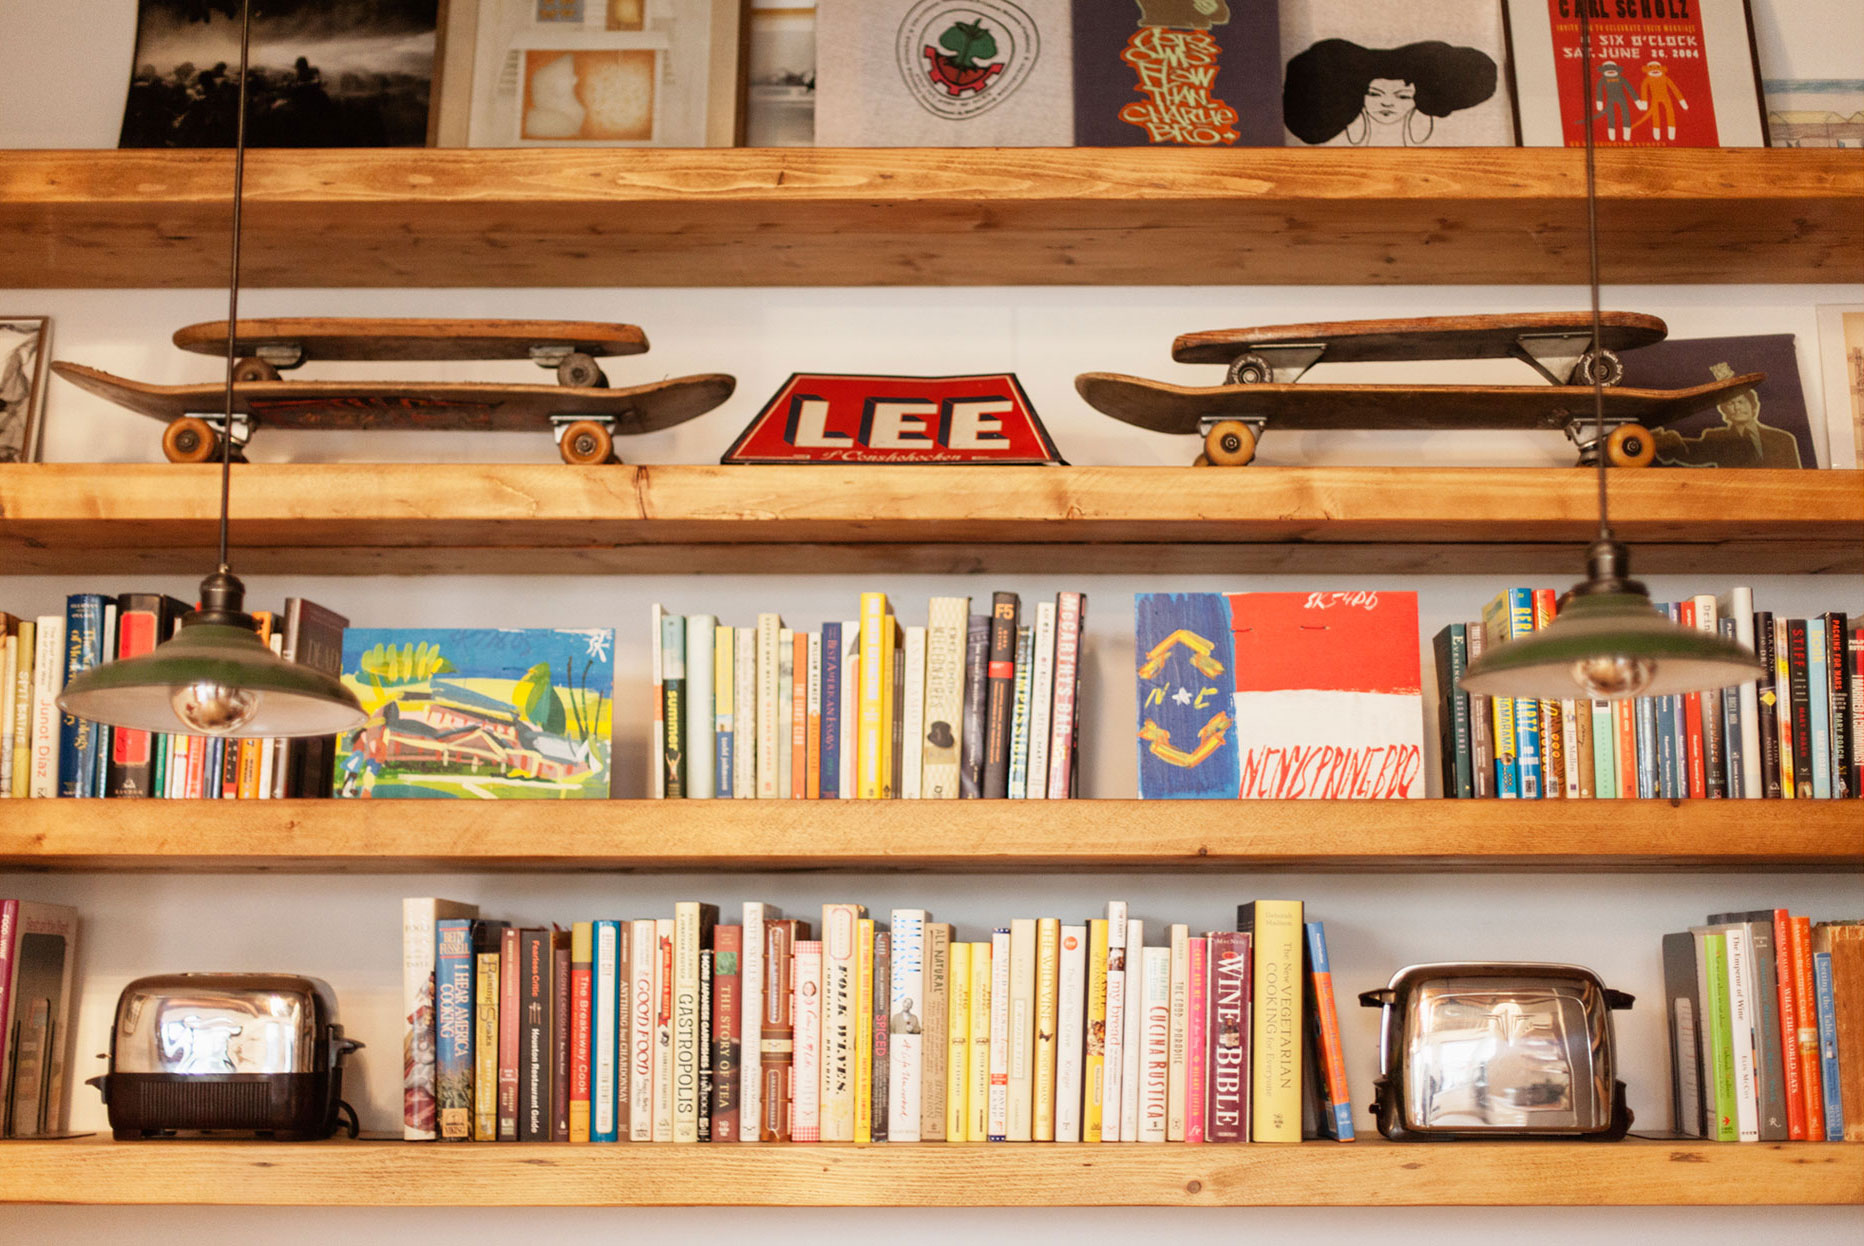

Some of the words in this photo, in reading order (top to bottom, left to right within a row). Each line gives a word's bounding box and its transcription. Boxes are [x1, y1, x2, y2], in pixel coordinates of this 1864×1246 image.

[1616, 0, 1690, 18] SCHOLZ
[1598, 48, 1641, 59] JUNE
[1599, 35, 1625, 46] SIX
[1631, 35, 1698, 47] O'CLOCK
[785, 393, 1014, 450] LEE
[994, 603, 1015, 620] F5
[71, 630, 83, 645] of
[826, 639, 838, 660] BEST
[1766, 620, 1775, 672] LEARNING
[1791, 628, 1805, 668] STIFF
[1811, 630, 1825, 663] bonk
[1832, 619, 1841, 652] PACKING
[1453, 635, 1464, 682] EVENING
[1833, 654, 1842, 669] FOR
[17, 671, 30, 701] SPIT
[825, 662, 838, 715] AMERICAN
[1834, 670, 1843, 690] MARS
[16, 703, 29, 744] BATHS
[39, 698, 51, 740] Junot
[667, 690, 679, 751] summer
[1055, 703, 1072, 735] BAR
[1456, 695, 1465, 722] SUSAN
[1798, 706, 1806, 728] MARY
[1834, 712, 1844, 733] MARY
[825, 717, 838, 751] ESSAYS
[1799, 731, 1808, 757] ROACH
[1816, 730, 1826, 750] MARY
[1836, 735, 1845, 759] ROACH
[37, 746, 50, 778] Díaz
[1568, 745, 1577, 772] Mullen
[1818, 751, 1828, 778] ROACH
[935, 929, 946, 946] ALL
[1043, 927, 1054, 953] THE
[1283, 942, 1293, 960] The
[1732, 936, 1742, 951] The
[531, 940, 541, 974] Fearless
[700, 955, 710, 979] MORE
[749, 945, 759, 984] SKILLS
[1193, 948, 1201, 971] CANDY
[1804, 938, 1812, 969] ROLAND
[559, 961, 568, 997] DISCOVER
[1041, 955, 1054, 991] WILD
[1065, 967, 1075, 982] The
[1193, 972, 1201, 987] AND
[1282, 962, 1292, 983] New
[1732, 952, 1744, 987] Emperor
[1820, 961, 1831, 993] Setting
[454, 972, 469, 1004] HEAR
[531, 976, 540, 997] Critic
[579, 976, 589, 997] The
[700, 981, 710, 1020] JAPANESE
[720, 985, 732, 1012] THE
[837, 964, 849, 1018] FOLK
[1092, 959, 1102, 1012] CONQUEST
[1108, 980, 1121, 1003] my
[1174, 981, 1184, 993] THE
[1193, 989, 1201, 1000] ME
[1217, 953, 1245, 1023] WINE
[1266, 962, 1278, 1034] COOKING
[1736, 989, 1745, 998] of
[1784, 987, 1793, 1014] WHAT
[440, 983, 454, 1038] COOKING
[619, 979, 629, 1026] ANYTHING
[636, 978, 651, 1027] GOOD
[1041, 992, 1053, 1022] VINE
[1063, 1005, 1074, 1021] You
[1736, 1000, 1746, 1020] Wine
[1822, 995, 1832, 1010] the
[451, 1006, 469, 1058] AMERICA
[559, 998, 567, 1040] CHOCOLATE
[577, 1000, 589, 1061] Breakaway
[619, 1028, 629, 1040] but
[1109, 1004, 1122, 1047] bread
[1148, 1005, 1170, 1055] CUCINA
[1785, 1015, 1793, 1034] THE
[1823, 1014, 1834, 1038] Table
[531, 1028, 541, 1062] Houston
[700, 1021, 710, 1070] GARNISHES
[719, 1015, 732, 1056] STORY
[875, 1014, 888, 1056] SPICED
[1063, 1022, 1074, 1048] Crave
[1265, 1036, 1275, 1050] for
[1280, 985, 1291, 1089] VEGETARIAN
[636, 1028, 651, 1076] FOOD
[678, 993, 694, 1114] GASTROPOLIS
[1787, 1036, 1797, 1070] WORLD
[578, 1064, 588, 1094] Cook
[618, 1042, 629, 1103] CHARDONNAY
[719, 1060, 731, 1077] OF
[1060, 1060, 1073, 1089] Krieger
[1191, 1066, 1200, 1093] HILARY
[1263, 1052, 1275, 1097] Everyone
[1790, 1071, 1799, 1094] EATS
[531, 1064, 541, 1108] Restaurant
[719, 1082, 731, 1108] TEA
[1146, 1060, 1168, 1119] RUSTICA
[1215, 1045, 1243, 1127] BIBLE
[530, 1109, 541, 1133] Guide
